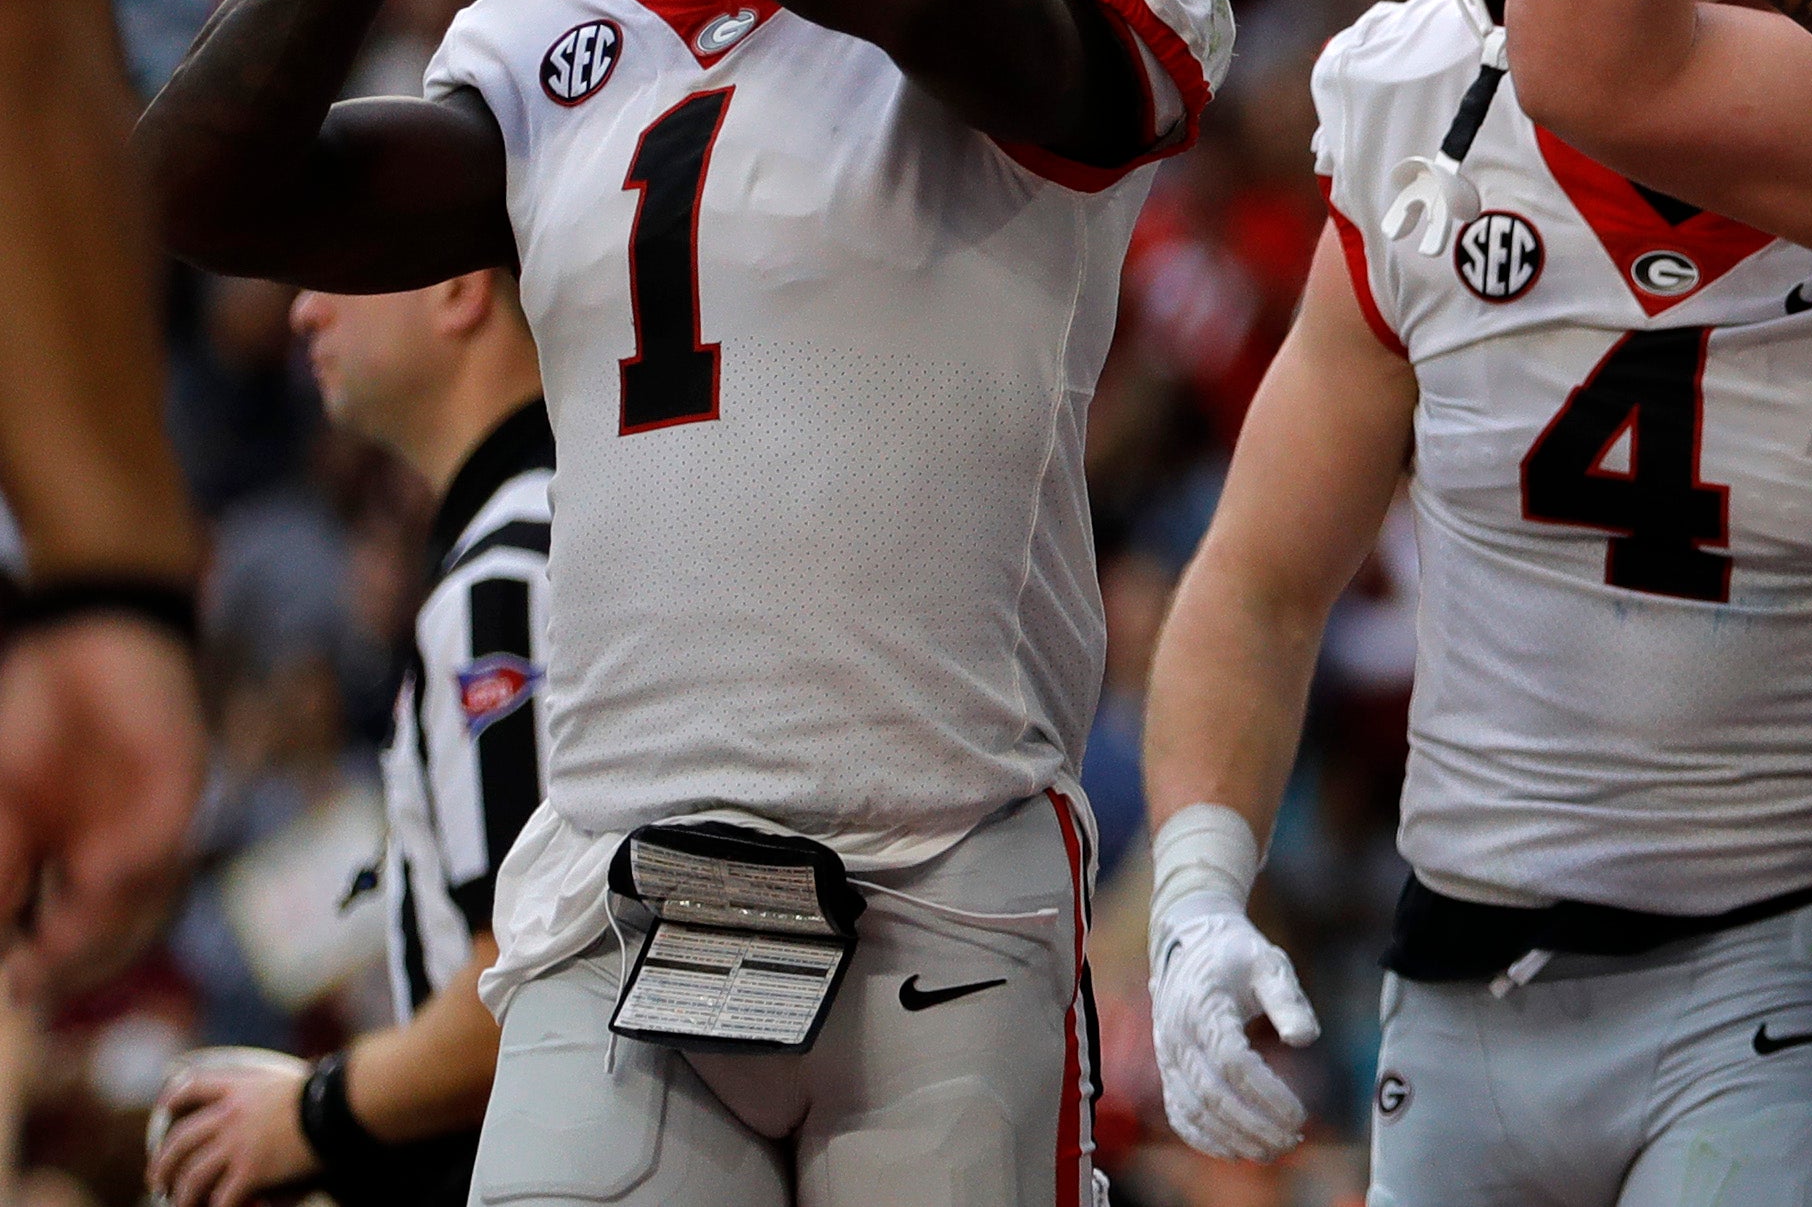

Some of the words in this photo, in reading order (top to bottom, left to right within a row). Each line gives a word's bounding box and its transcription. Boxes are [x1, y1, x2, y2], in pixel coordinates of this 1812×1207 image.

[547, 23, 615, 99] SEC
[618, 84, 736, 437] 1
[1460, 214, 1537, 296] SEC
[1631, 249, 1699, 296] G
[1519, 326, 1733, 604] 4
[1378, 1076, 1406, 1113] G
